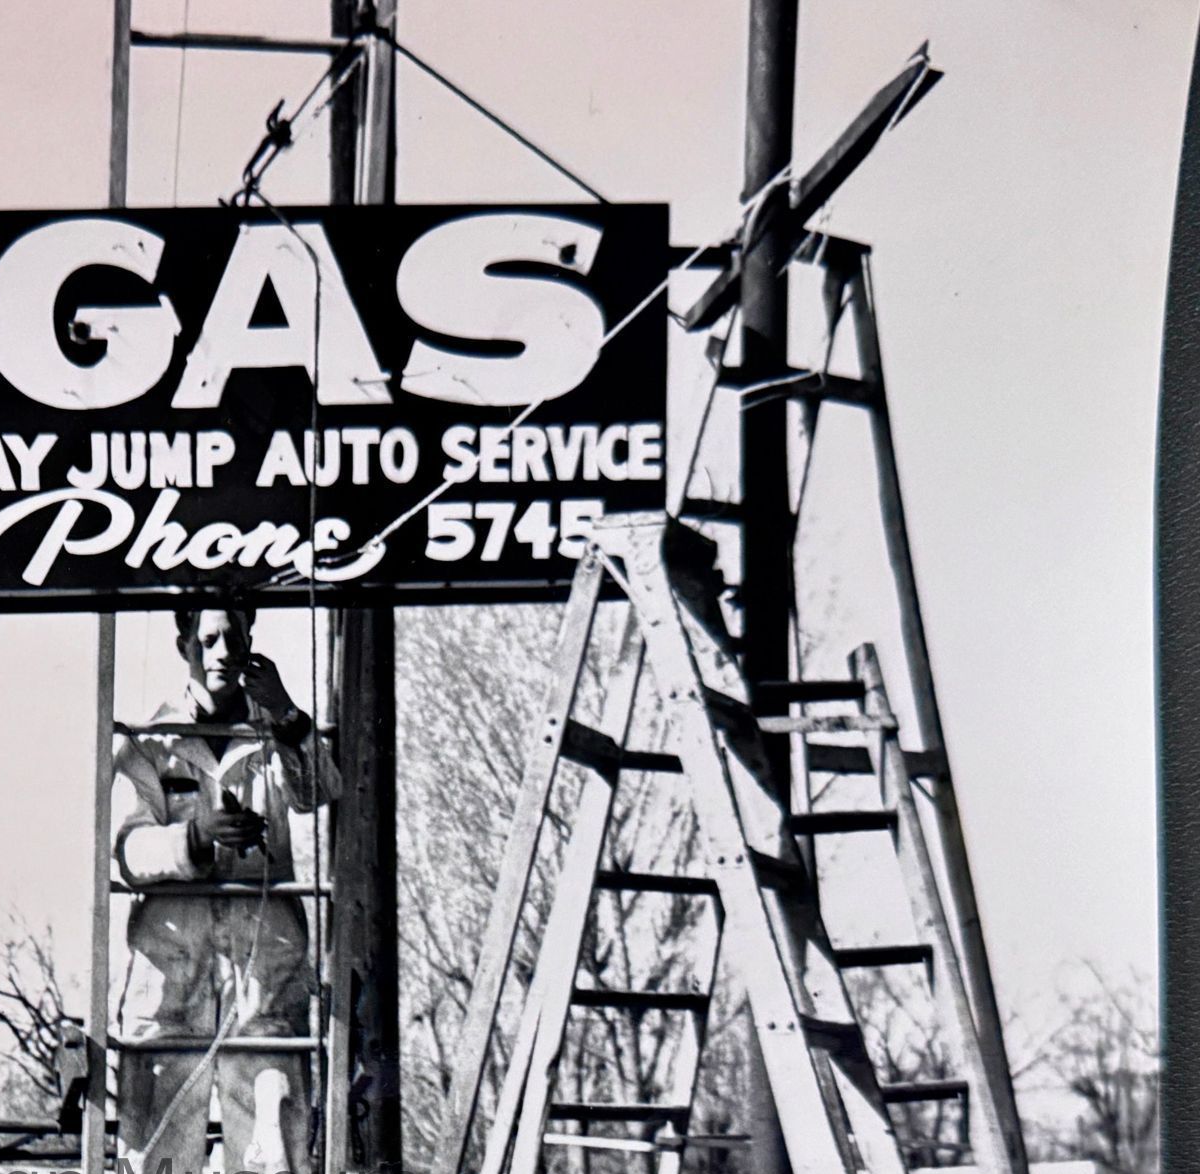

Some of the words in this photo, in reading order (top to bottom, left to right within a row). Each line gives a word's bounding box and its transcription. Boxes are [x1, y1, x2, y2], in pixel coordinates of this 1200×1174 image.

[66, 431, 236, 490] JUMP
[255, 427, 419, 487] AUTO
[440, 422, 663, 483] SERVICE
[425, 500, 604, 562] 5745
